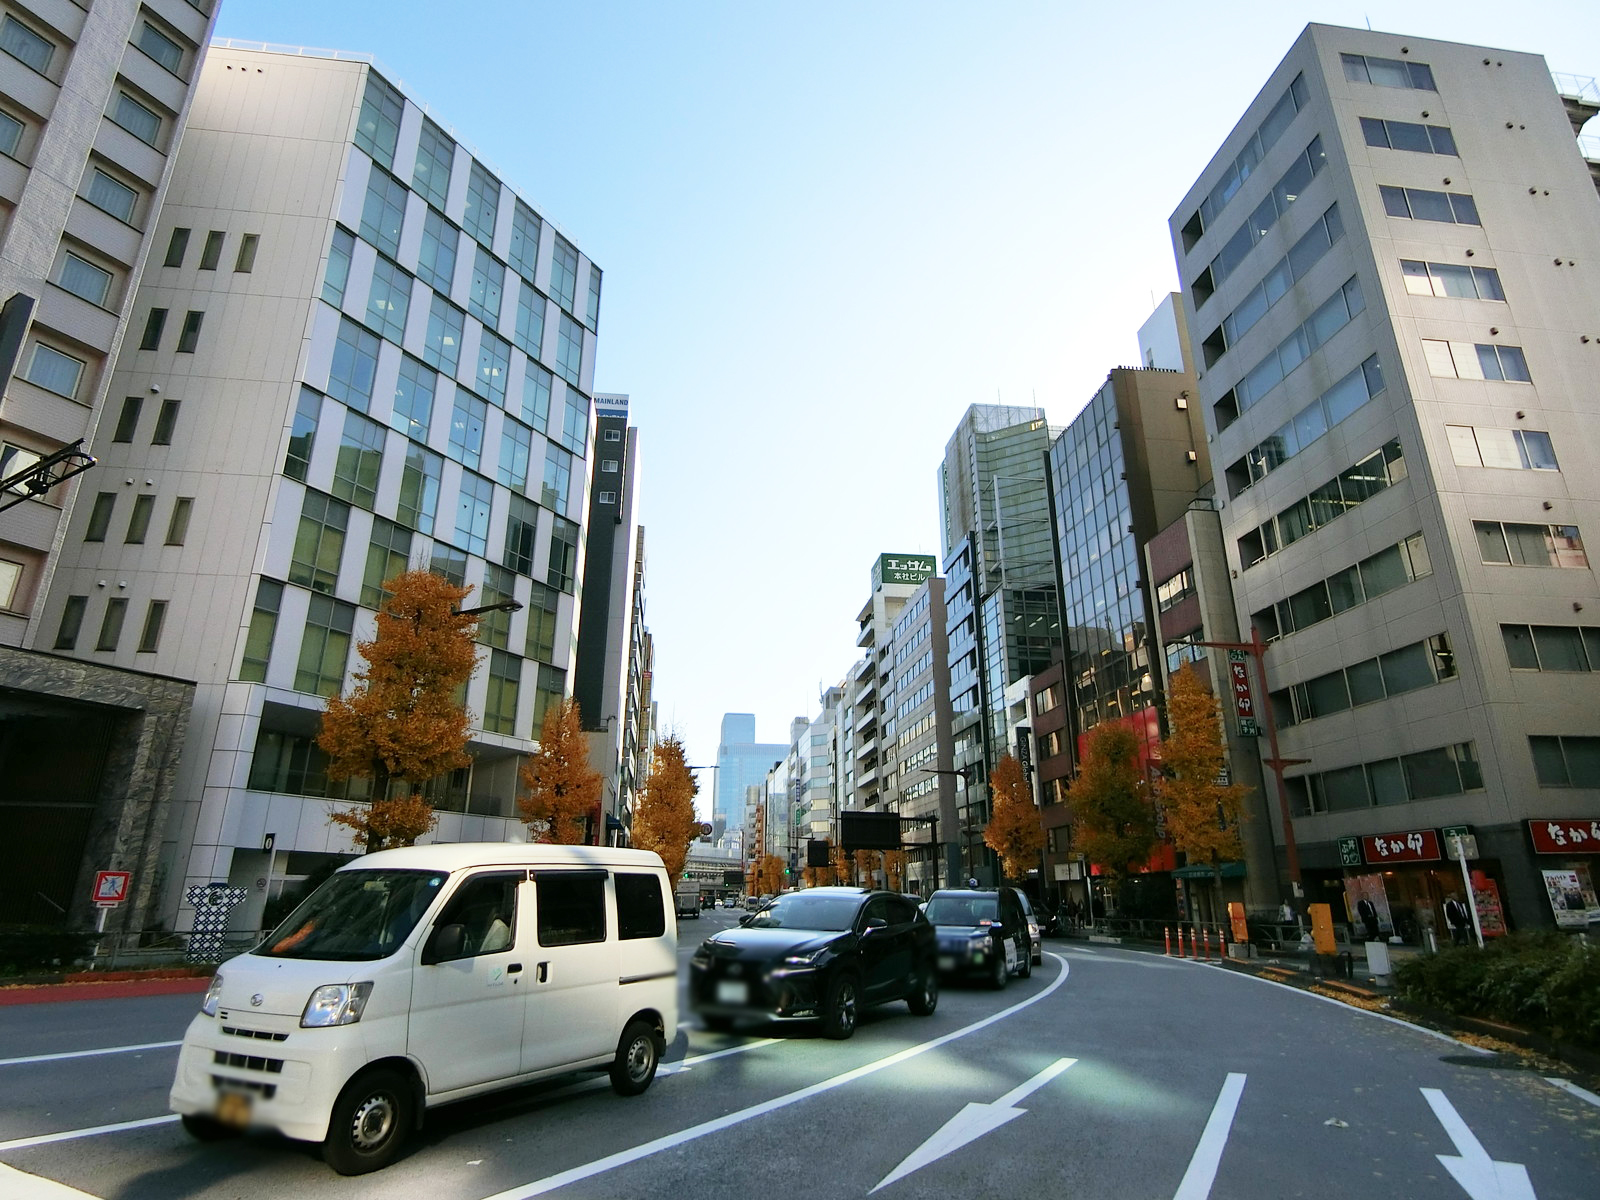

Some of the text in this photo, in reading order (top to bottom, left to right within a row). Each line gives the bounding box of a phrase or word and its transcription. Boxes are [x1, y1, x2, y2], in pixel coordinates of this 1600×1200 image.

[594, 397, 628, 406] MAINLAND
[887, 559, 932, 571] エッサム
[894, 572, 926, 581] 本社ビル
[1233, 665, 1251, 712] なか卯
[1374, 833, 1423, 857] なか卯
